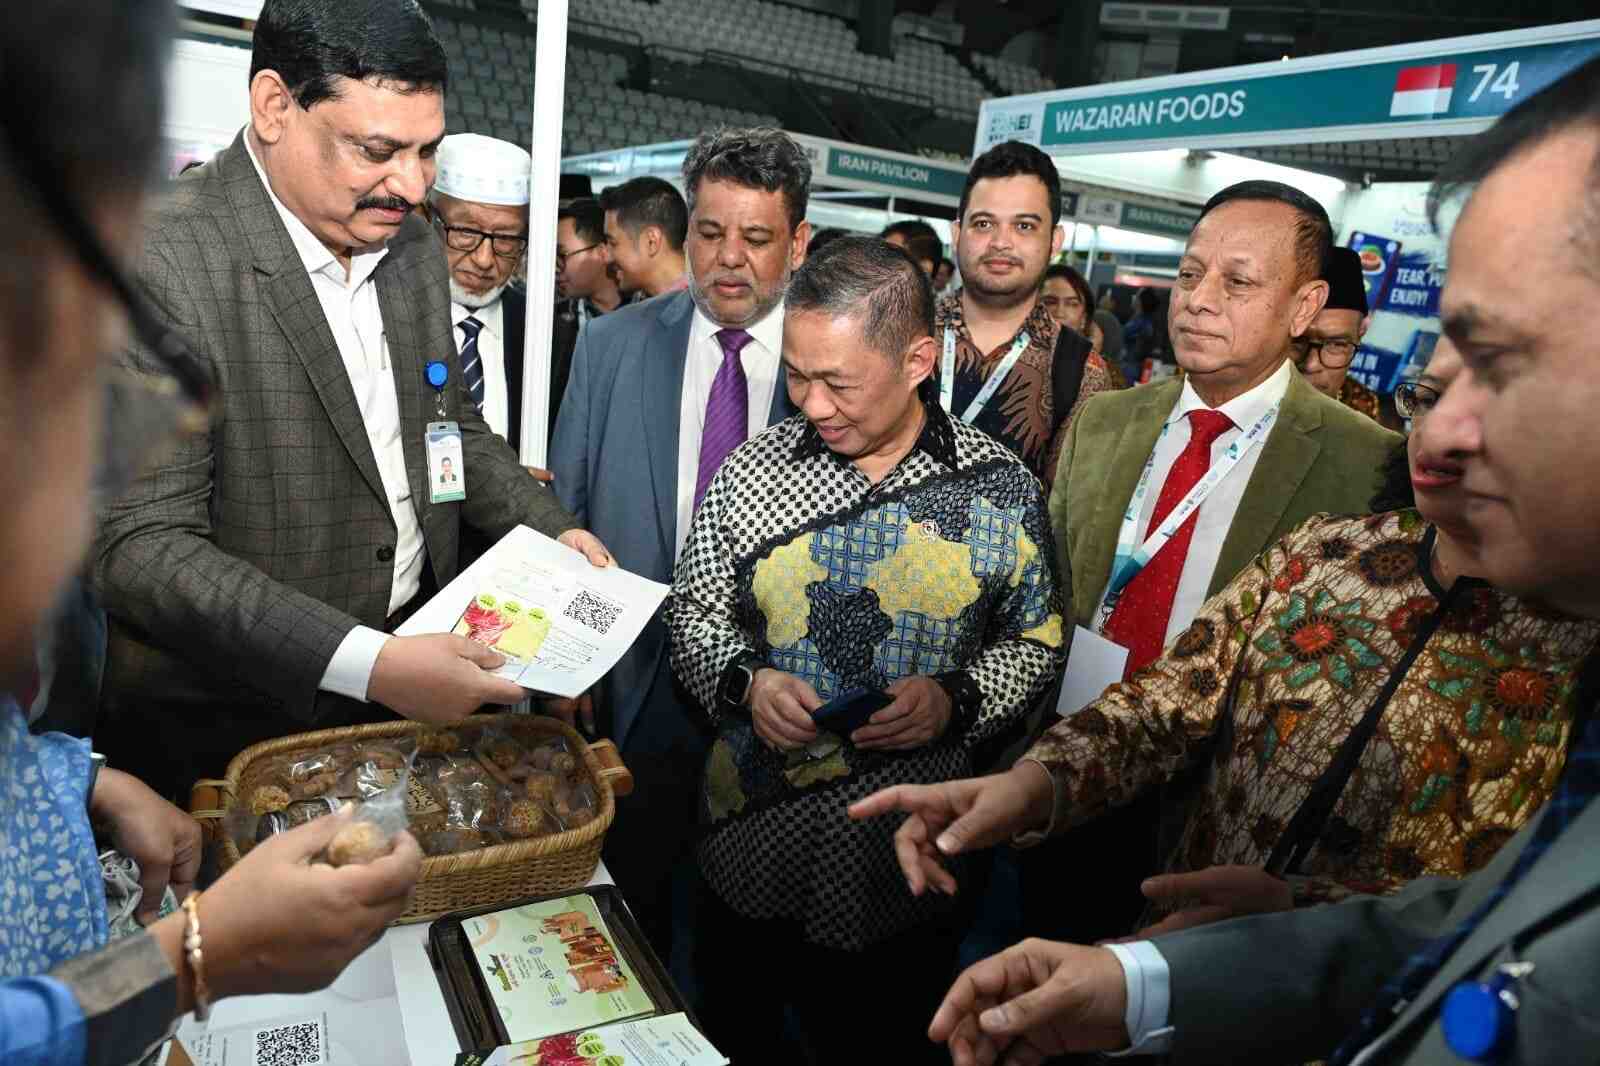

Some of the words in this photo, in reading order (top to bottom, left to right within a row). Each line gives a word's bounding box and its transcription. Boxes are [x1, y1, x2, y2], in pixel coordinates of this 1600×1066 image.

[1468, 61, 1520, 103] 74
[1056, 101, 1153, 134] WAZARAN
[1156, 90, 1246, 125] FOODS
[838, 155, 870, 172] IRAN
[871, 160, 929, 183] PAVILION
[1389, 287, 1429, 306] ENJOY!
